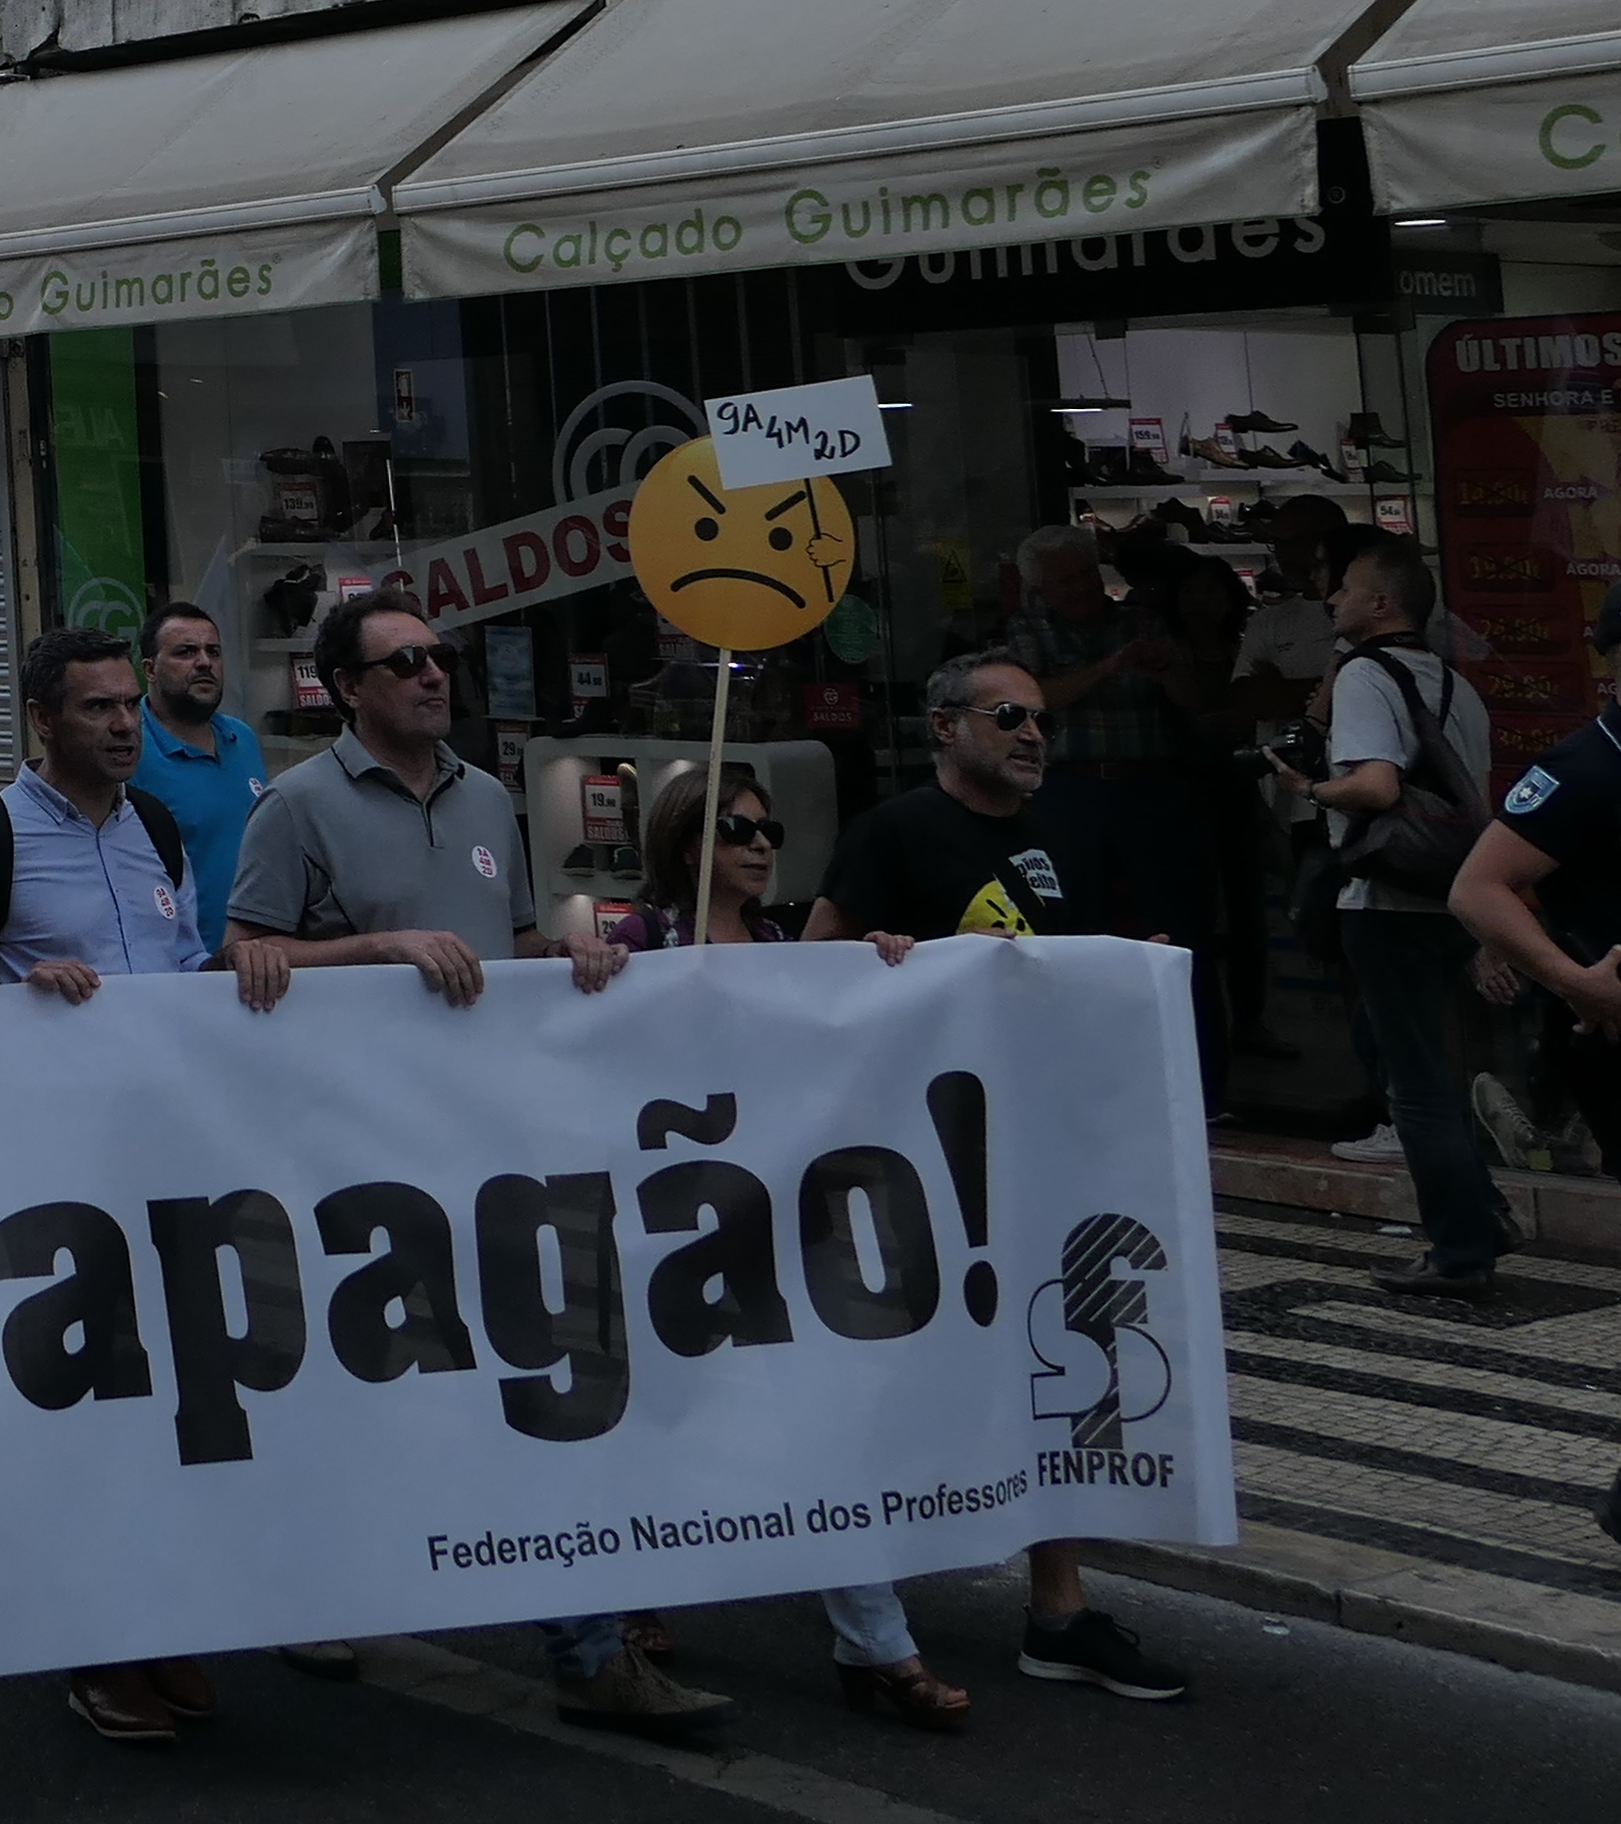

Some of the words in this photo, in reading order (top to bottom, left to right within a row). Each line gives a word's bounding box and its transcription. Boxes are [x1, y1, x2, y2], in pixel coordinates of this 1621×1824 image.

[503, 207, 743, 275] Calçado
[784, 167, 1152, 246] Guimarães
[41, 258, 273, 316] Guimarães
[1398, 269, 1477, 298] omem
[1492, 389, 1595, 409] SENHORA
[1600, 389, 1614, 406] E
[717, 401, 763, 435] 9A
[766, 415, 810, 450] 4M
[814, 429, 861, 461] 2D
[1543, 485, 1598, 500] AGORA
[1036, 1448, 1176, 1489] FENPROF
[426, 1520, 621, 1572] Federação
[629, 1499, 795, 1552] Nacional
[806, 1497, 872, 1534] dos
[881, 1467, 1028, 1526] Professores
